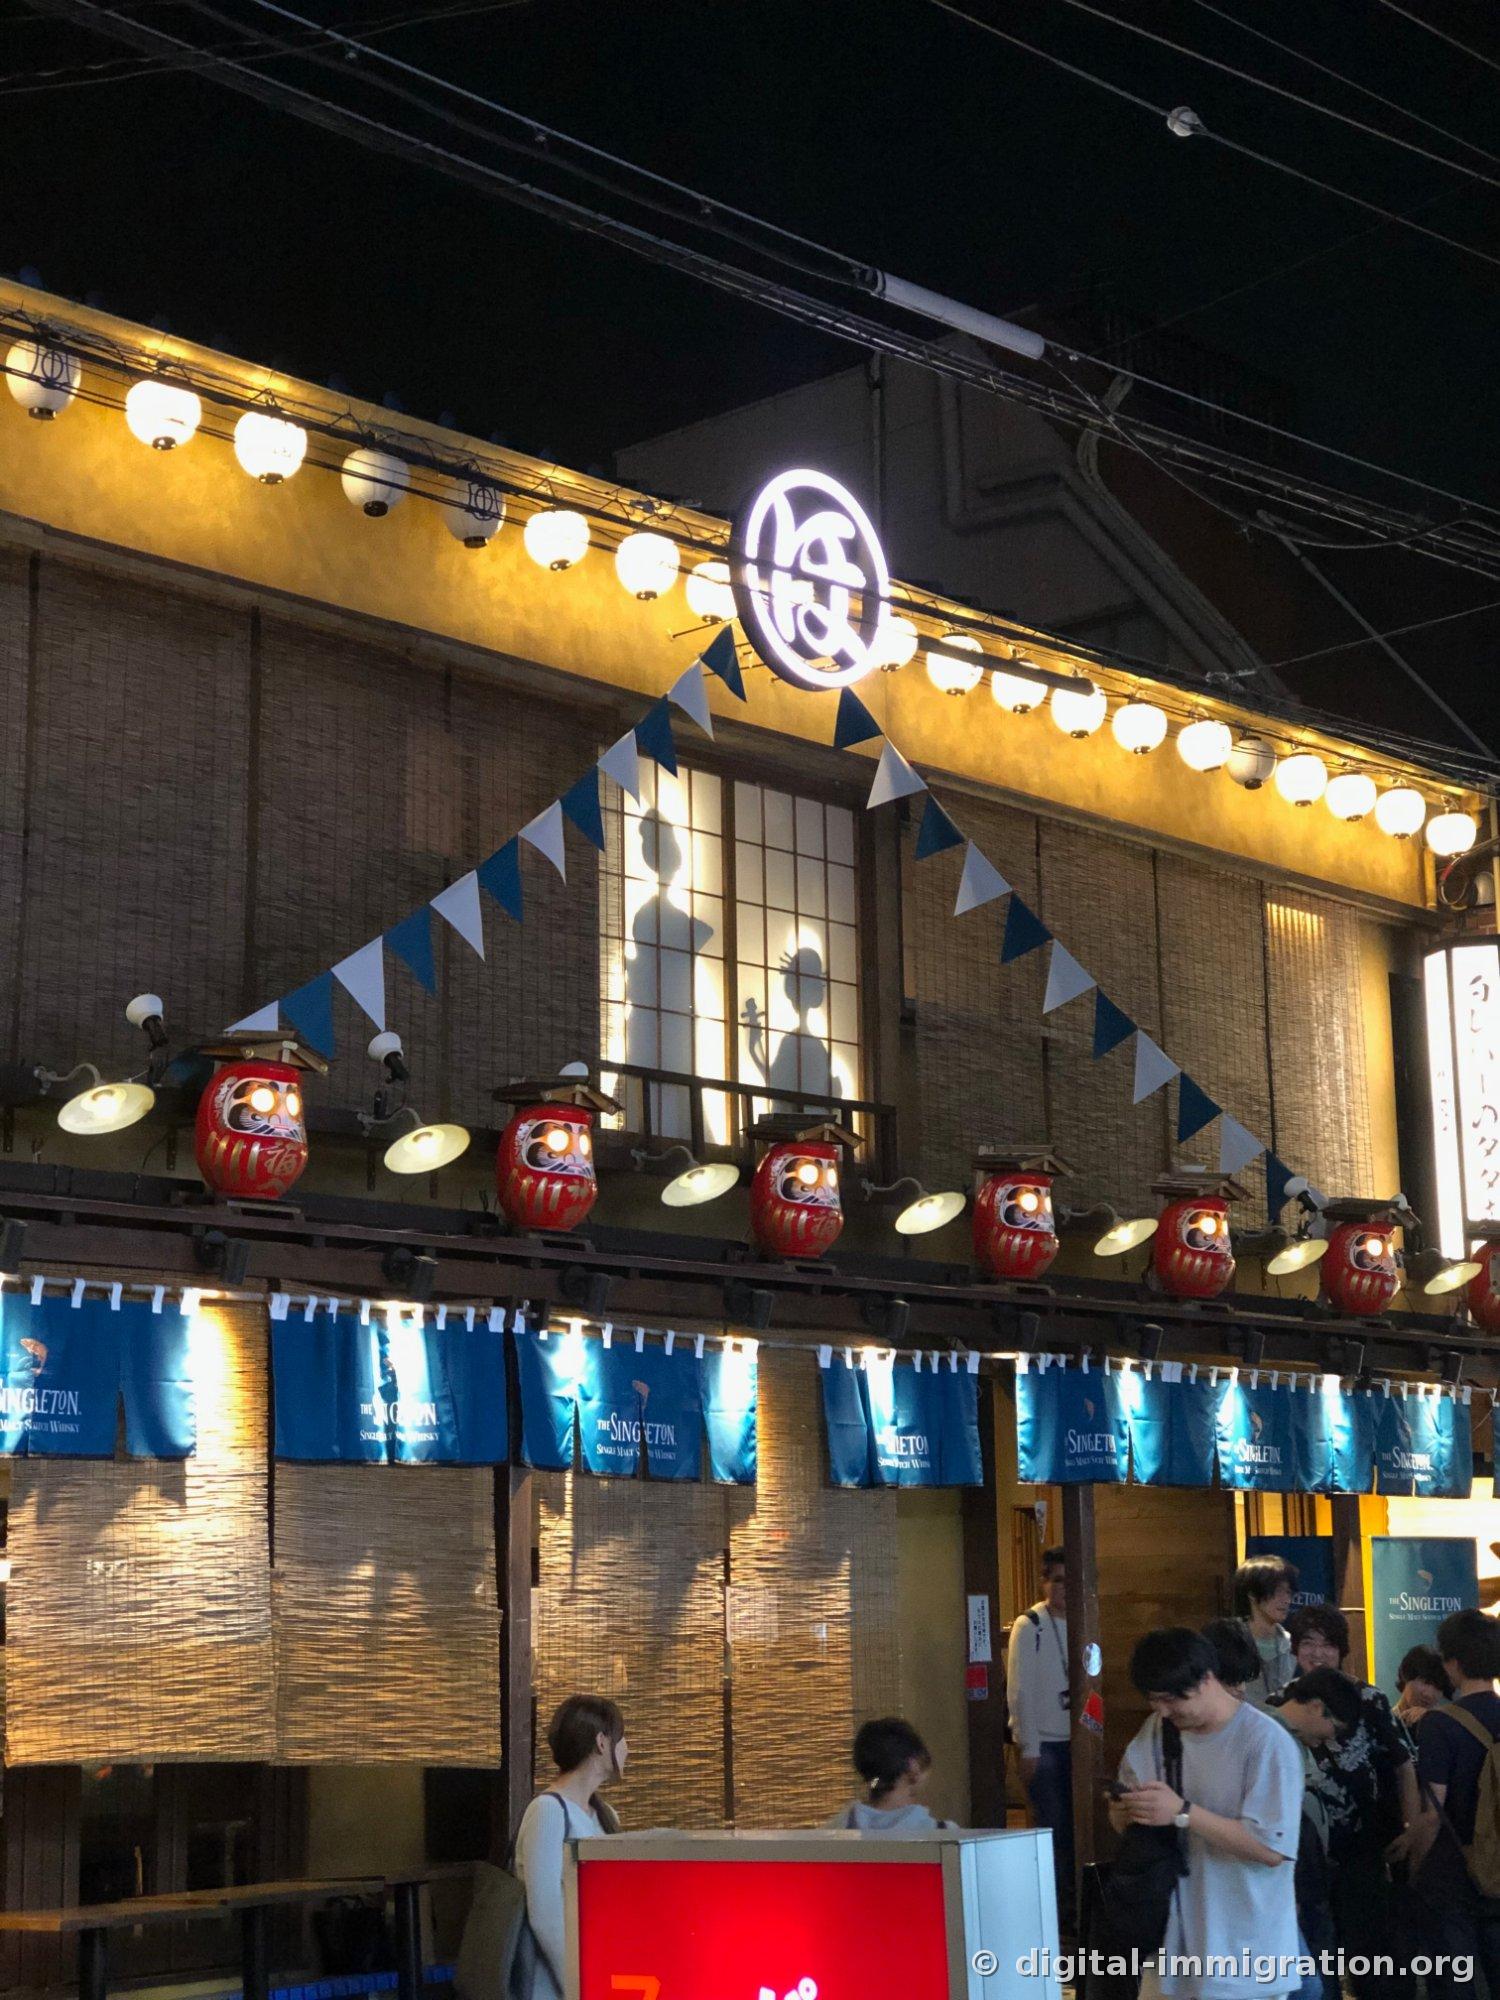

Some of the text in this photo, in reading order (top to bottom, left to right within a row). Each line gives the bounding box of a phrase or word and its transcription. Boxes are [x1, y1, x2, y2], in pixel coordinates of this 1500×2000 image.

[360, 1403, 373, 1415] THE
[597, 1412, 678, 1446] THE SINGETON.
[1389, 1591, 1462, 1611] THE SINGLETON
